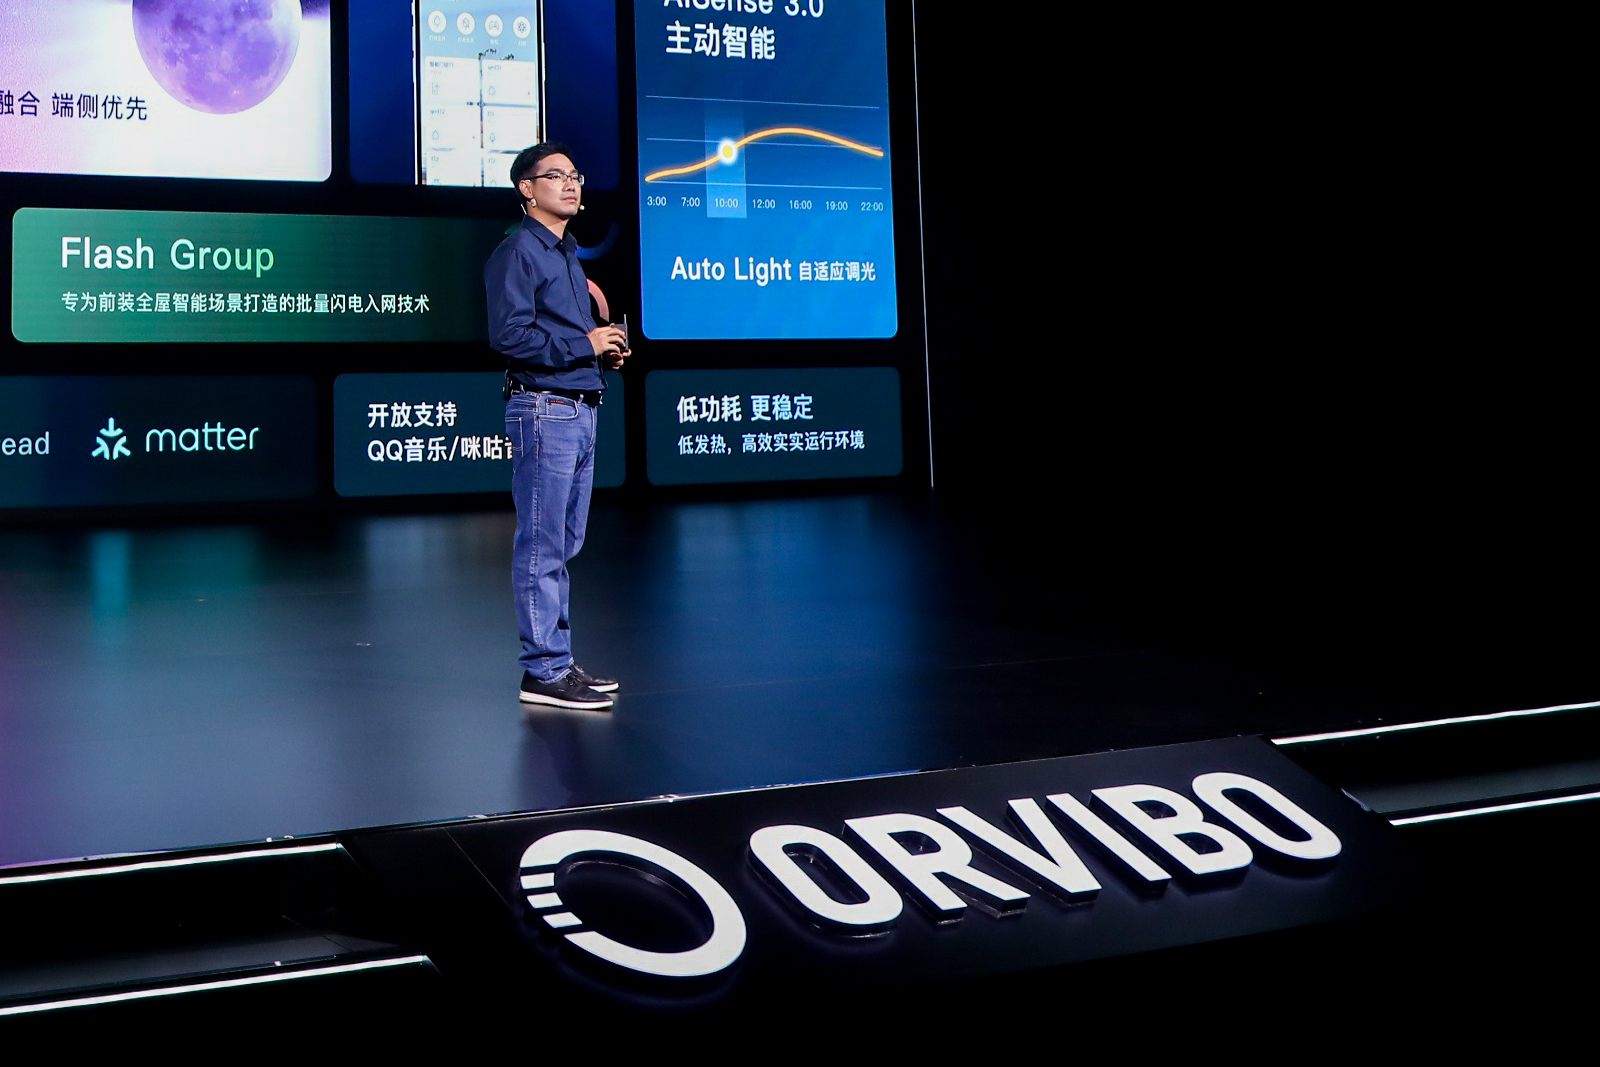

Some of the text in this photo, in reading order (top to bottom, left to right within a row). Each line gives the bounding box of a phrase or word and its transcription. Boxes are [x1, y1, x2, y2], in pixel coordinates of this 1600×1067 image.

[666, 20, 775, 59] 主动智能
[51, 92, 149, 121] 端侧优先
[647, 196, 884, 211] 3:00 7:00 10:00 12:00 16:00 19:00 22:00
[60, 236, 276, 278] Flash Group
[670, 257, 877, 287] Auto Light 自适应调光
[60, 291, 431, 315] 专为前装全屋智能场景打造的批量闪电入网技术
[368, 401, 457, 428] 开放支持
[677, 394, 813, 423] 低功耗 更稳定
[146, 422, 259, 452] matter
[748, 772, 1342, 926] ORVIBO
